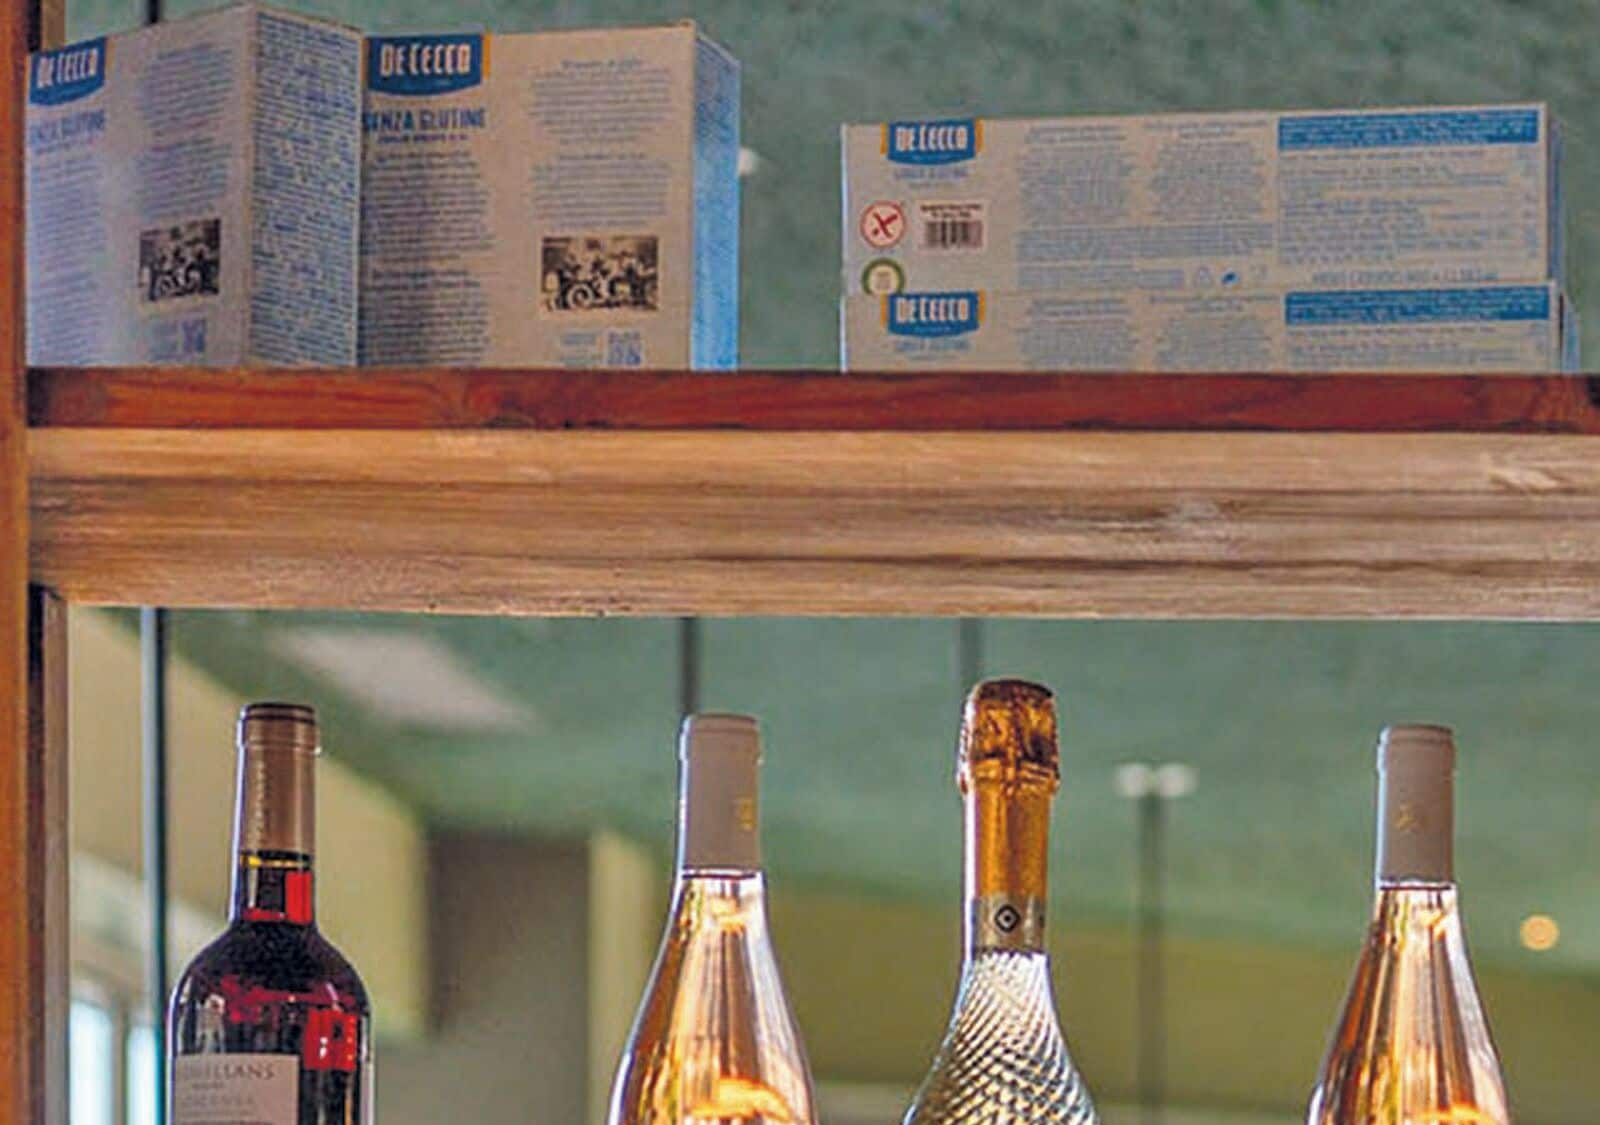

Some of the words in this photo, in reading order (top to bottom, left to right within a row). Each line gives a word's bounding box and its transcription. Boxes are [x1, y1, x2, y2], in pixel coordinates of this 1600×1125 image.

[379, 43, 406, 77] DE
[408, 43, 471, 76] CECCO
[894, 125, 917, 152] DE
[918, 124, 968, 152] CECCO
[895, 296, 917, 324] DE
[919, 296, 969, 323] CECCO
